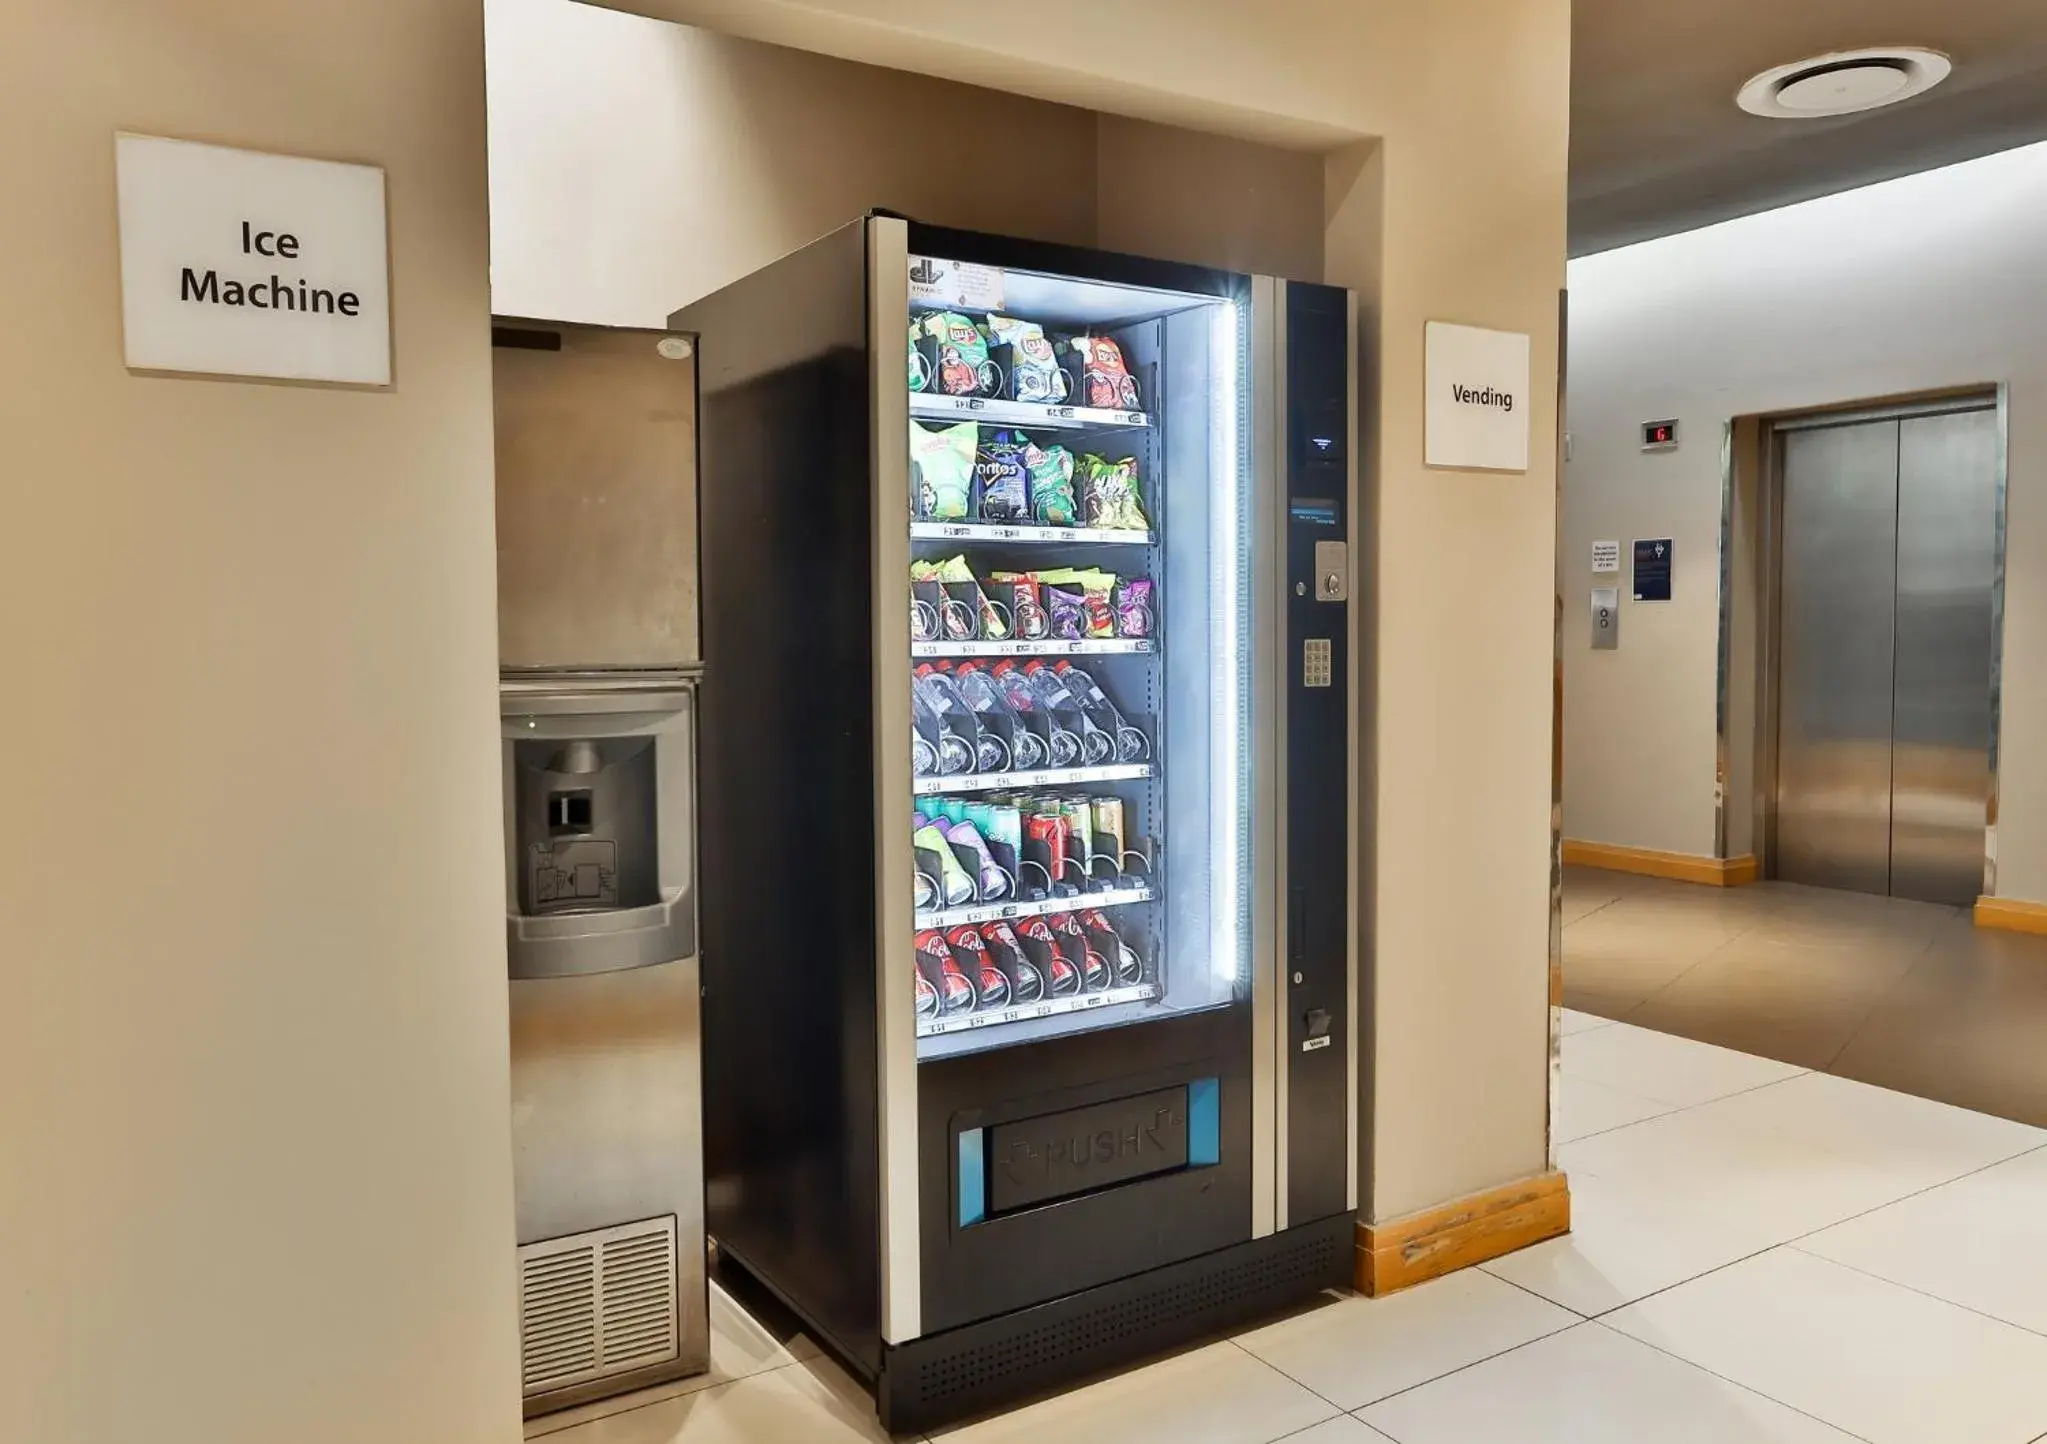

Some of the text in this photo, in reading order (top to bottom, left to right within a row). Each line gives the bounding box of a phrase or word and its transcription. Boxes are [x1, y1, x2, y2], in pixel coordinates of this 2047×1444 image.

[242, 221, 299, 259] Ice
[181, 267, 360, 316] Machine
[1452, 383, 1513, 412] Vending
[1046, 1124, 1142, 1177] PUSH
